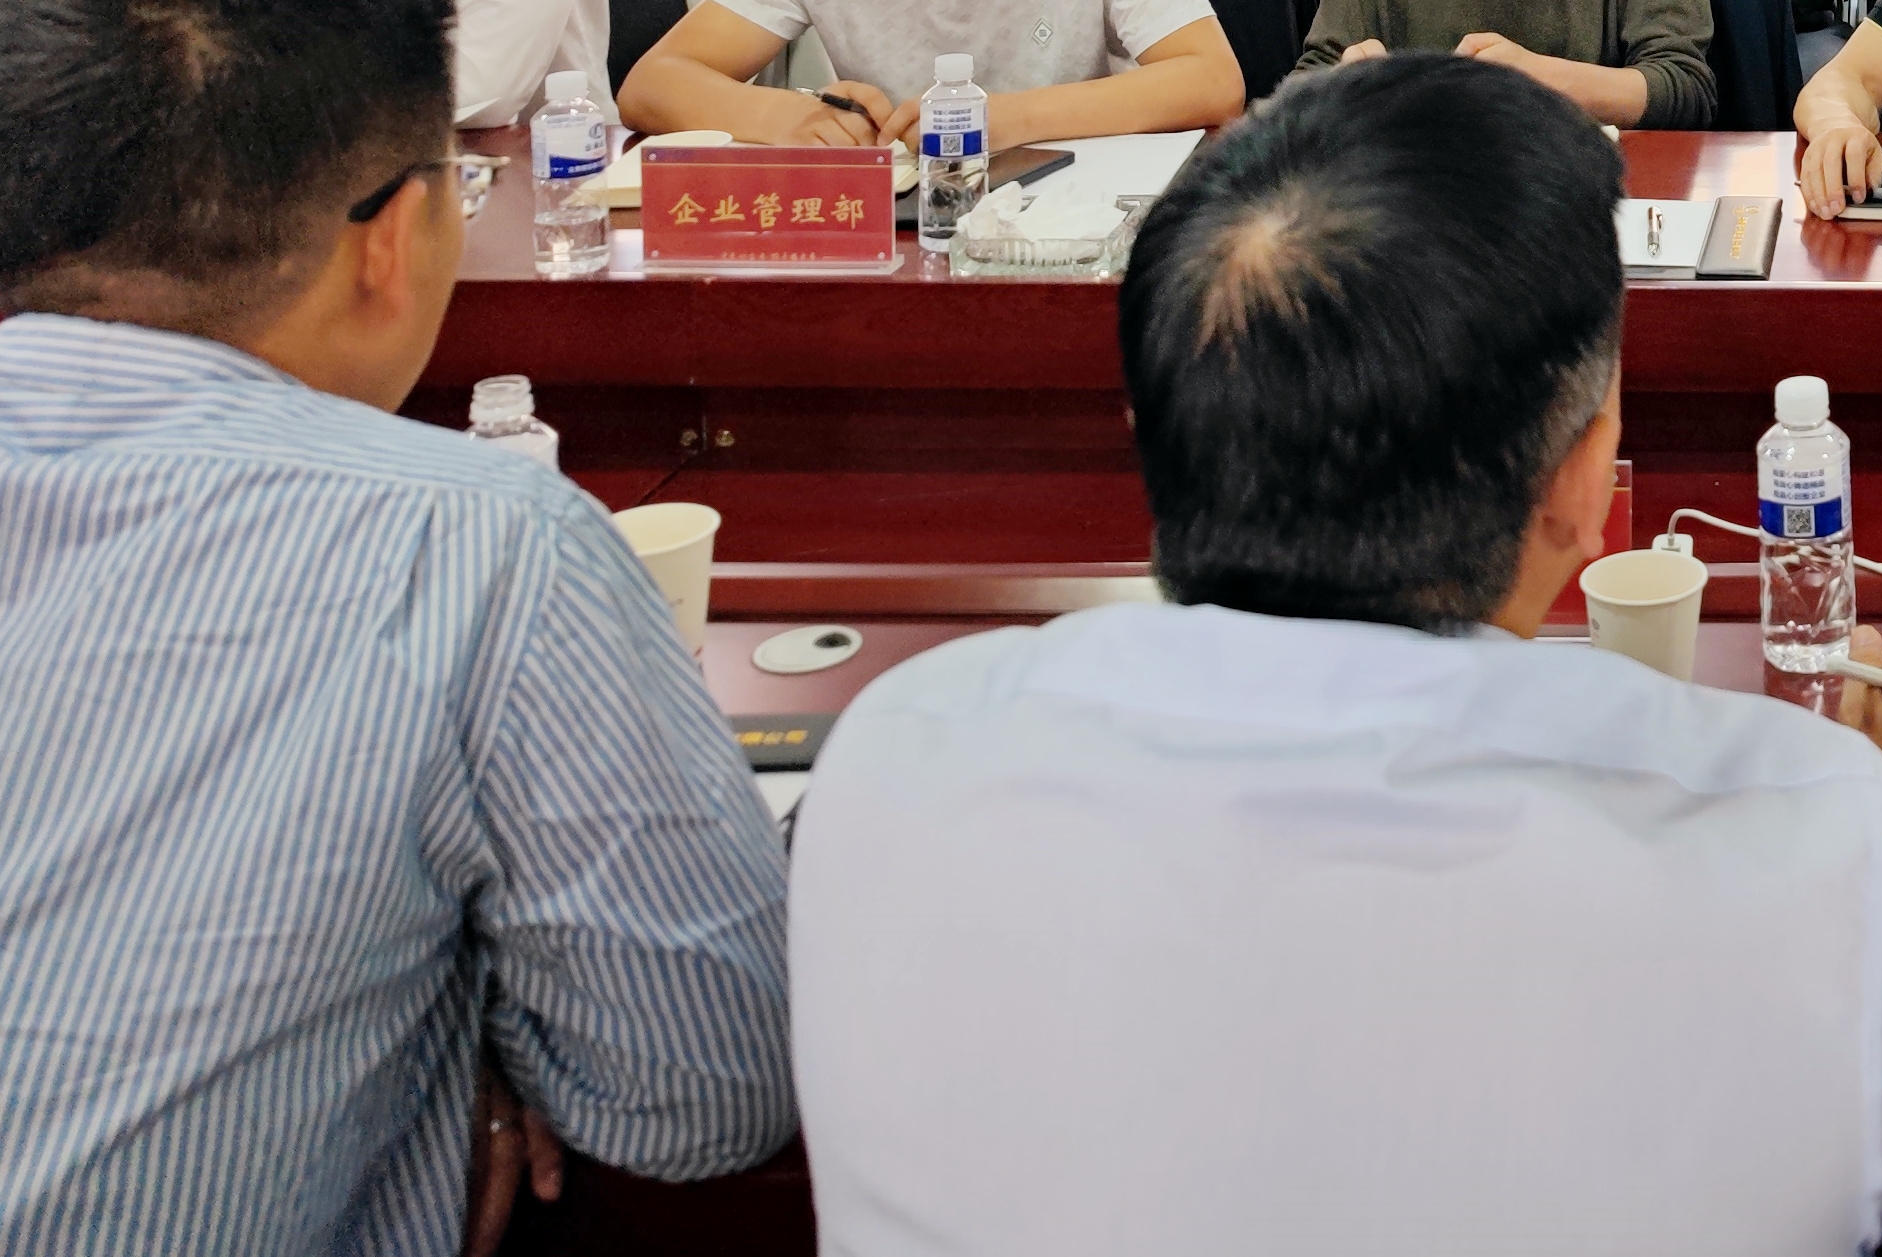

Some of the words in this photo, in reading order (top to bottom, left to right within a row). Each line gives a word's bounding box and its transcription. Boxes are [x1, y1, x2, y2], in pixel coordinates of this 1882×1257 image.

[668, 192, 865, 230] 企业管理部
